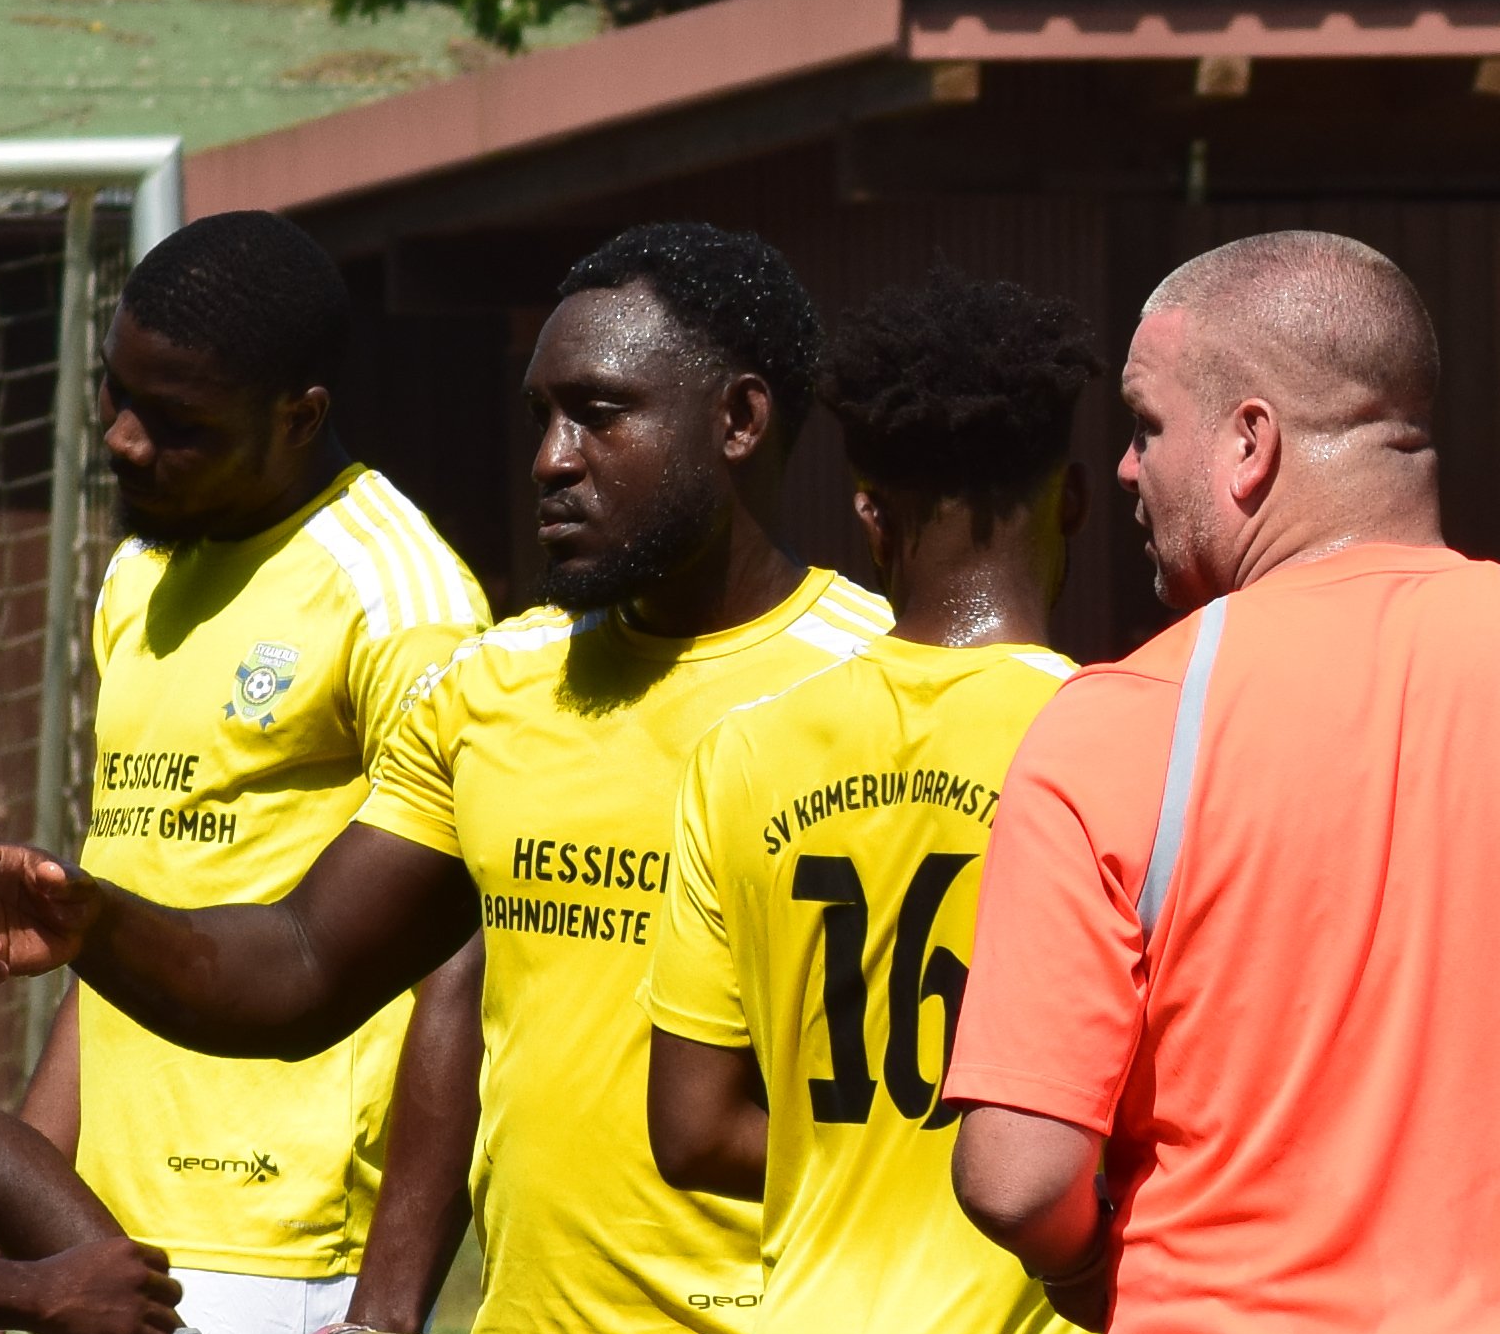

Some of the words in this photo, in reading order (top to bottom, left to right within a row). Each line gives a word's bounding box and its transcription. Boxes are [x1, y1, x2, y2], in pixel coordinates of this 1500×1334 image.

[101, 752, 200, 793] HESSISCHE
[159, 808, 237, 844] GMBH
[763, 810, 791, 855] SV
[794, 771, 908, 831] KAMERUN
[911, 769, 1000, 829] DARMST
[485, 893, 651, 945] BAHNDIENSTE
[792, 852, 981, 1130] 16
[688, 1294, 764, 1309] geo
